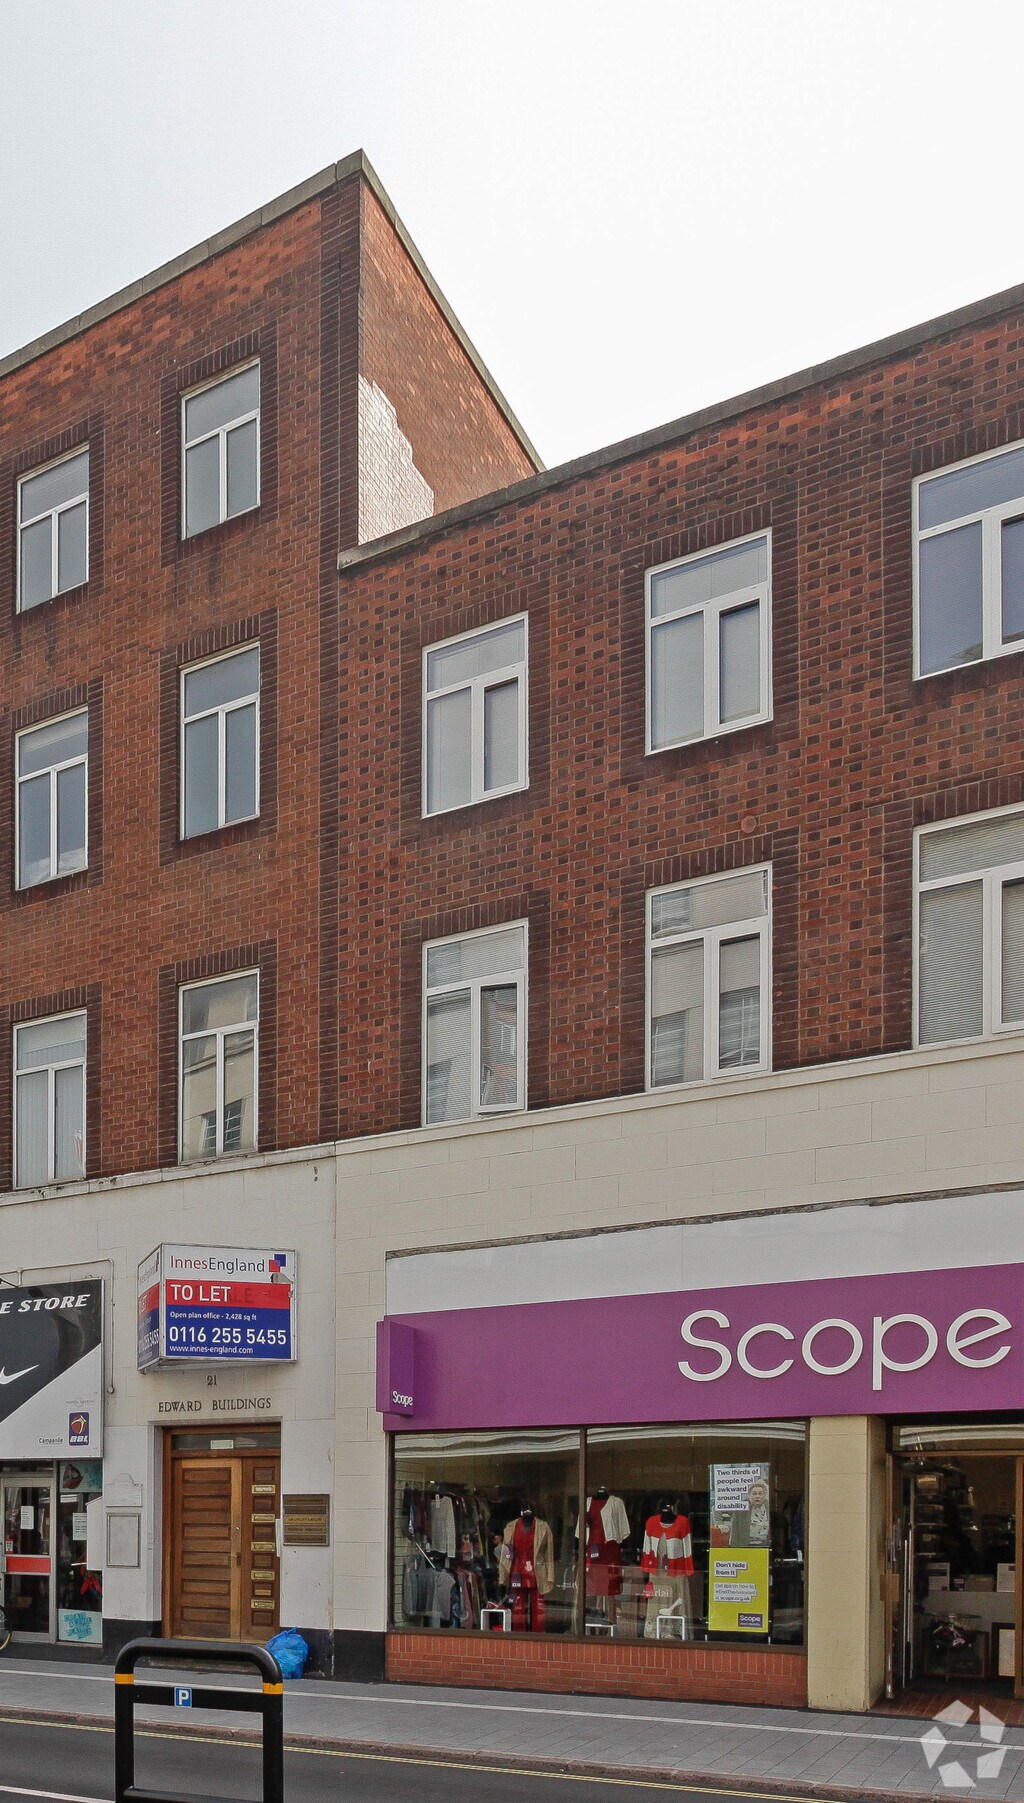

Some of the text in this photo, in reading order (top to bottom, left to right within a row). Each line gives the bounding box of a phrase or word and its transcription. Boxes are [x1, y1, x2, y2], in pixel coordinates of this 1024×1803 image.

[170, 1255, 265, 1275] InnesEngland
[170, 1284, 194, 1301] TO
[199, 1285, 231, 1302] LET
[17, 1293, 91, 1314] STORE
[169, 1310, 187, 1319] Open
[187, 1312, 202, 1320] plan
[202, 1311, 220, 1319] office
[225, 1313, 242, 1321] 2,428
[243, 1314, 250, 1322] sq
[169, 1326, 287, 1346] 0116 255 5455
[169, 1345, 254, 1355] www.innes-england.com
[678, 1308, 1012, 1391] Scope
[206, 1375, 217, 1386] 21
[158, 1397, 272, 1413] EDWARD BUILDINGS
[392, 1390, 413, 1408] Scope
[716, 1478, 740, 1486] people
[739, 1614, 762, 1623] Scope
[178, 1689, 190, 1706] P
